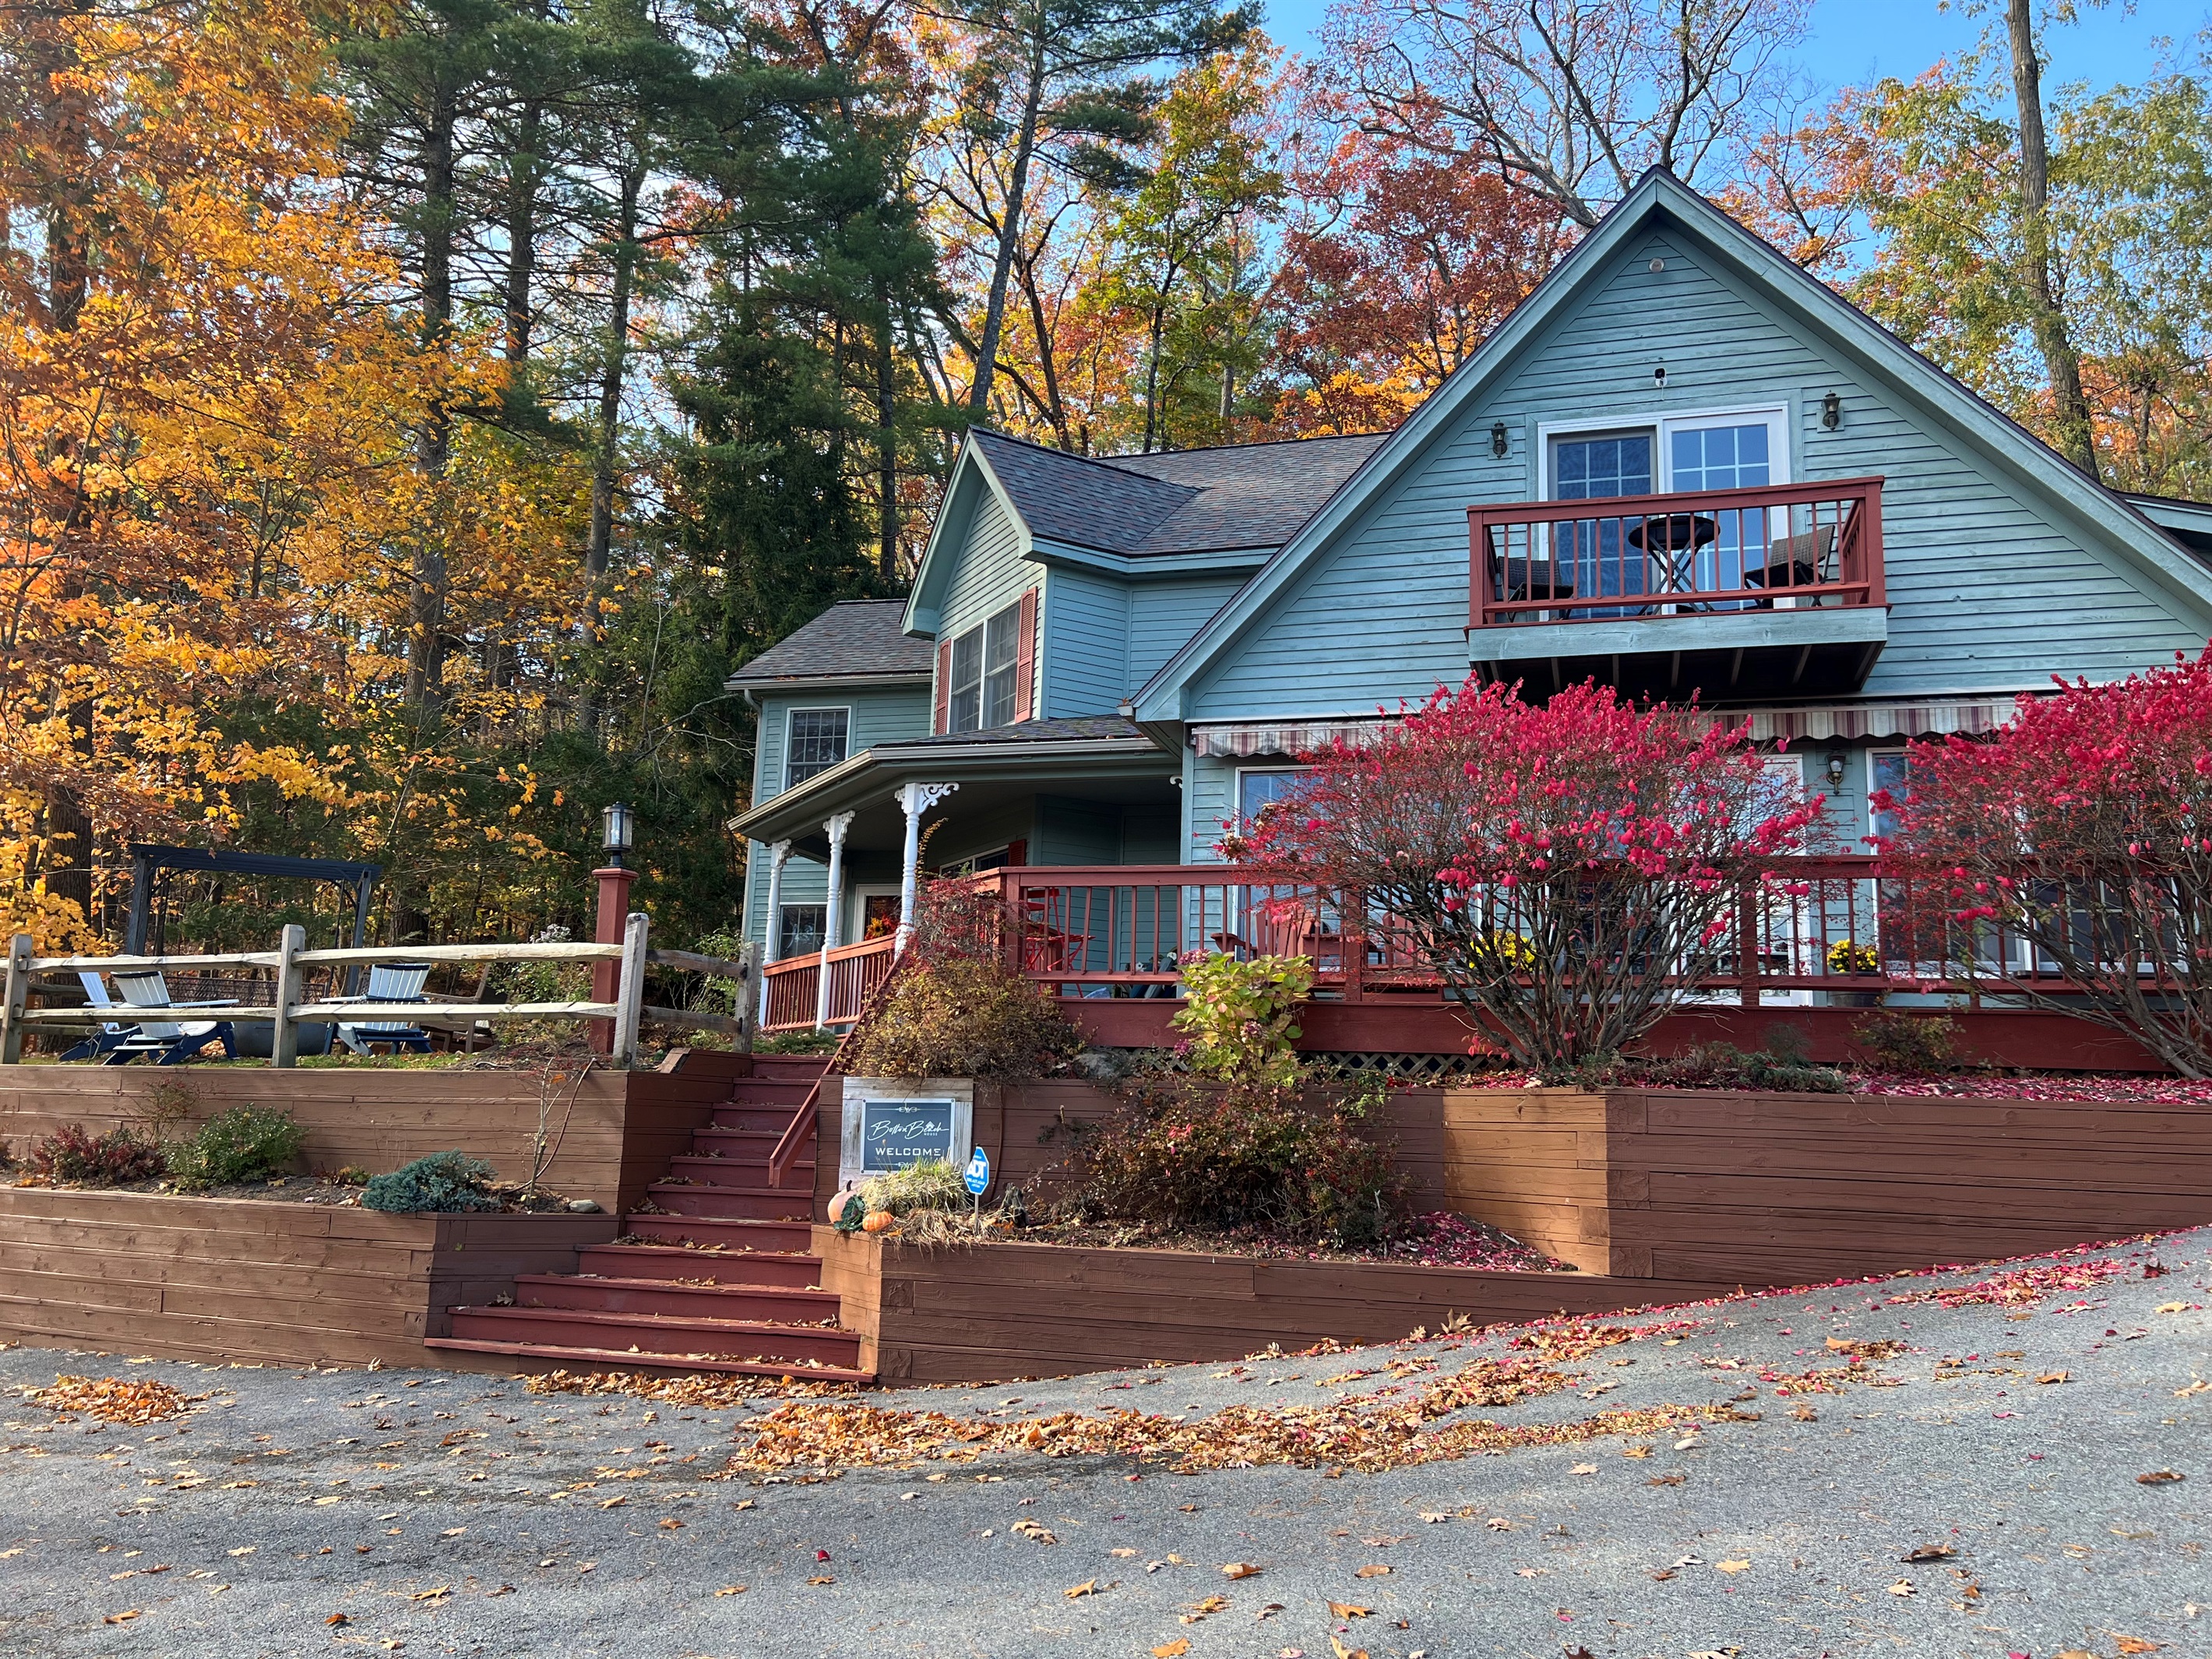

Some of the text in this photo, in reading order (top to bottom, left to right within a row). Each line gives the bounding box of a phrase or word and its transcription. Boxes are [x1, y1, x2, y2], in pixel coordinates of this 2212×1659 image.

[904, 1120, 949, 1139] Beach
[875, 1147, 942, 1156] WELCOME
[966, 1159, 987, 1179] ADT
